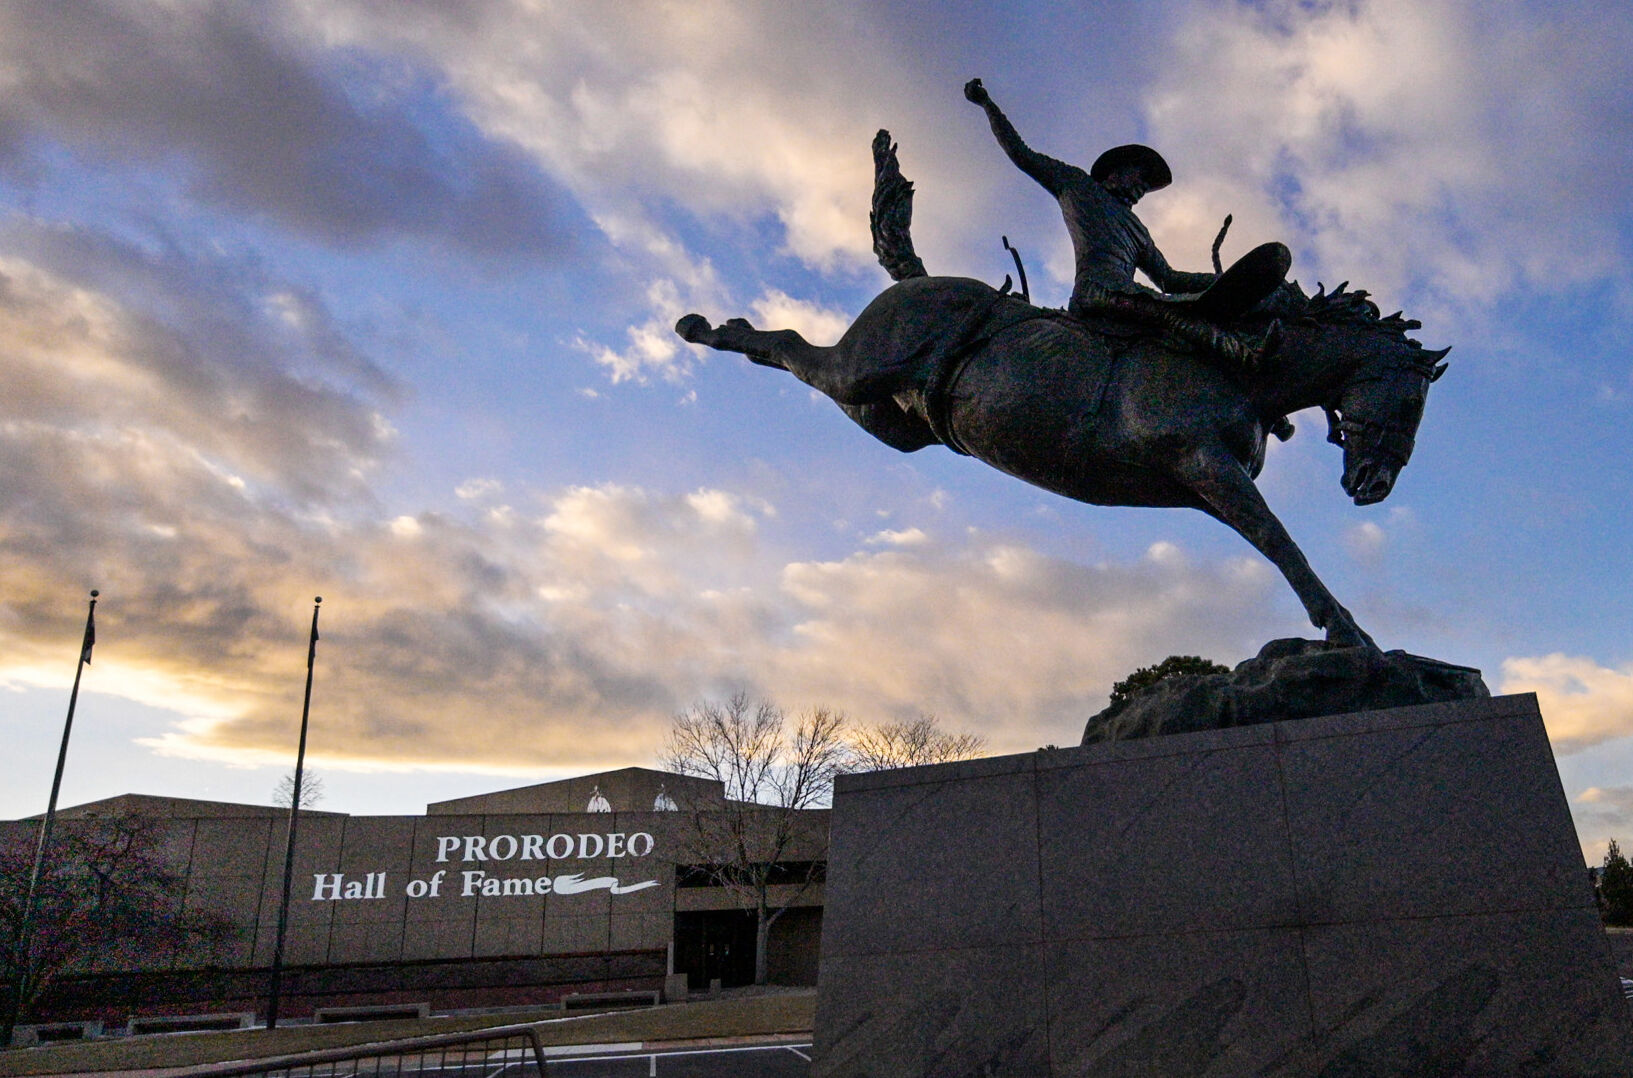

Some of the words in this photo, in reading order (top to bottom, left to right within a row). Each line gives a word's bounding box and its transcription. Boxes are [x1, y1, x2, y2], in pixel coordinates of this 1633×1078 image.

[436, 833, 655, 862] PRORODEO
[311, 872, 386, 901] Hall
[406, 870, 447, 898] of
[461, 871, 552, 897] Fame
